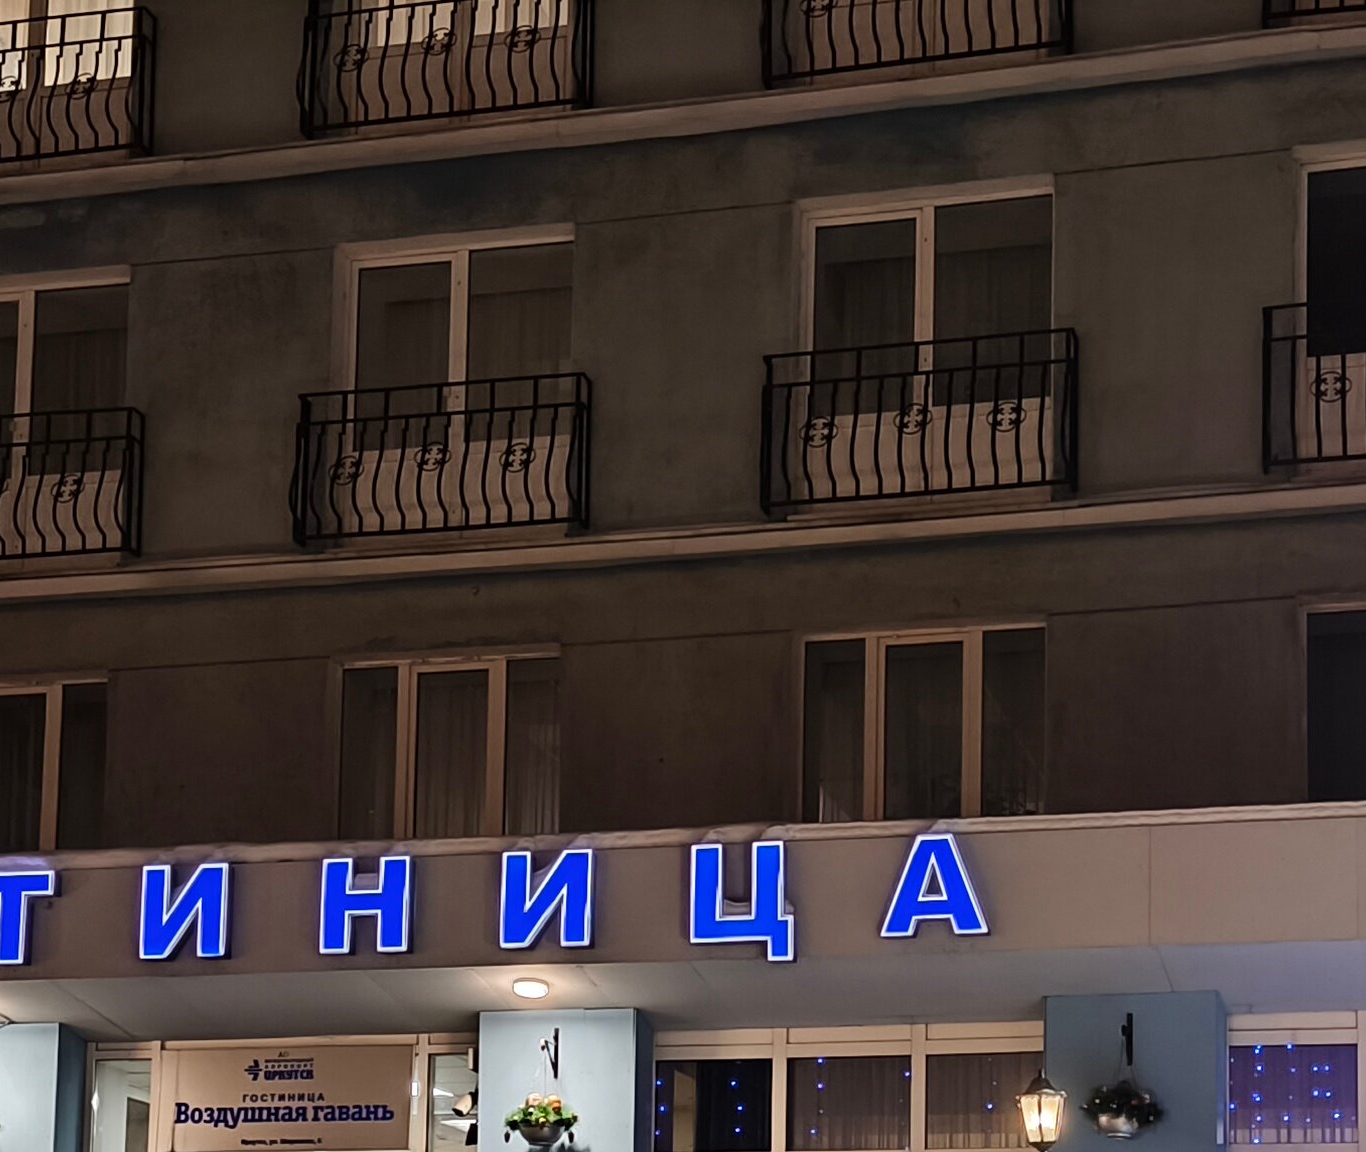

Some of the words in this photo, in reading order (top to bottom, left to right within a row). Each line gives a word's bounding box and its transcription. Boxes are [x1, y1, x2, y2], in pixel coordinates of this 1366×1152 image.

[242, 1092, 325, 1103] ГОСТИНИЦА
[174, 1102, 308, 1129] Воздушная
[312, 1103, 395, 1123] гавань
